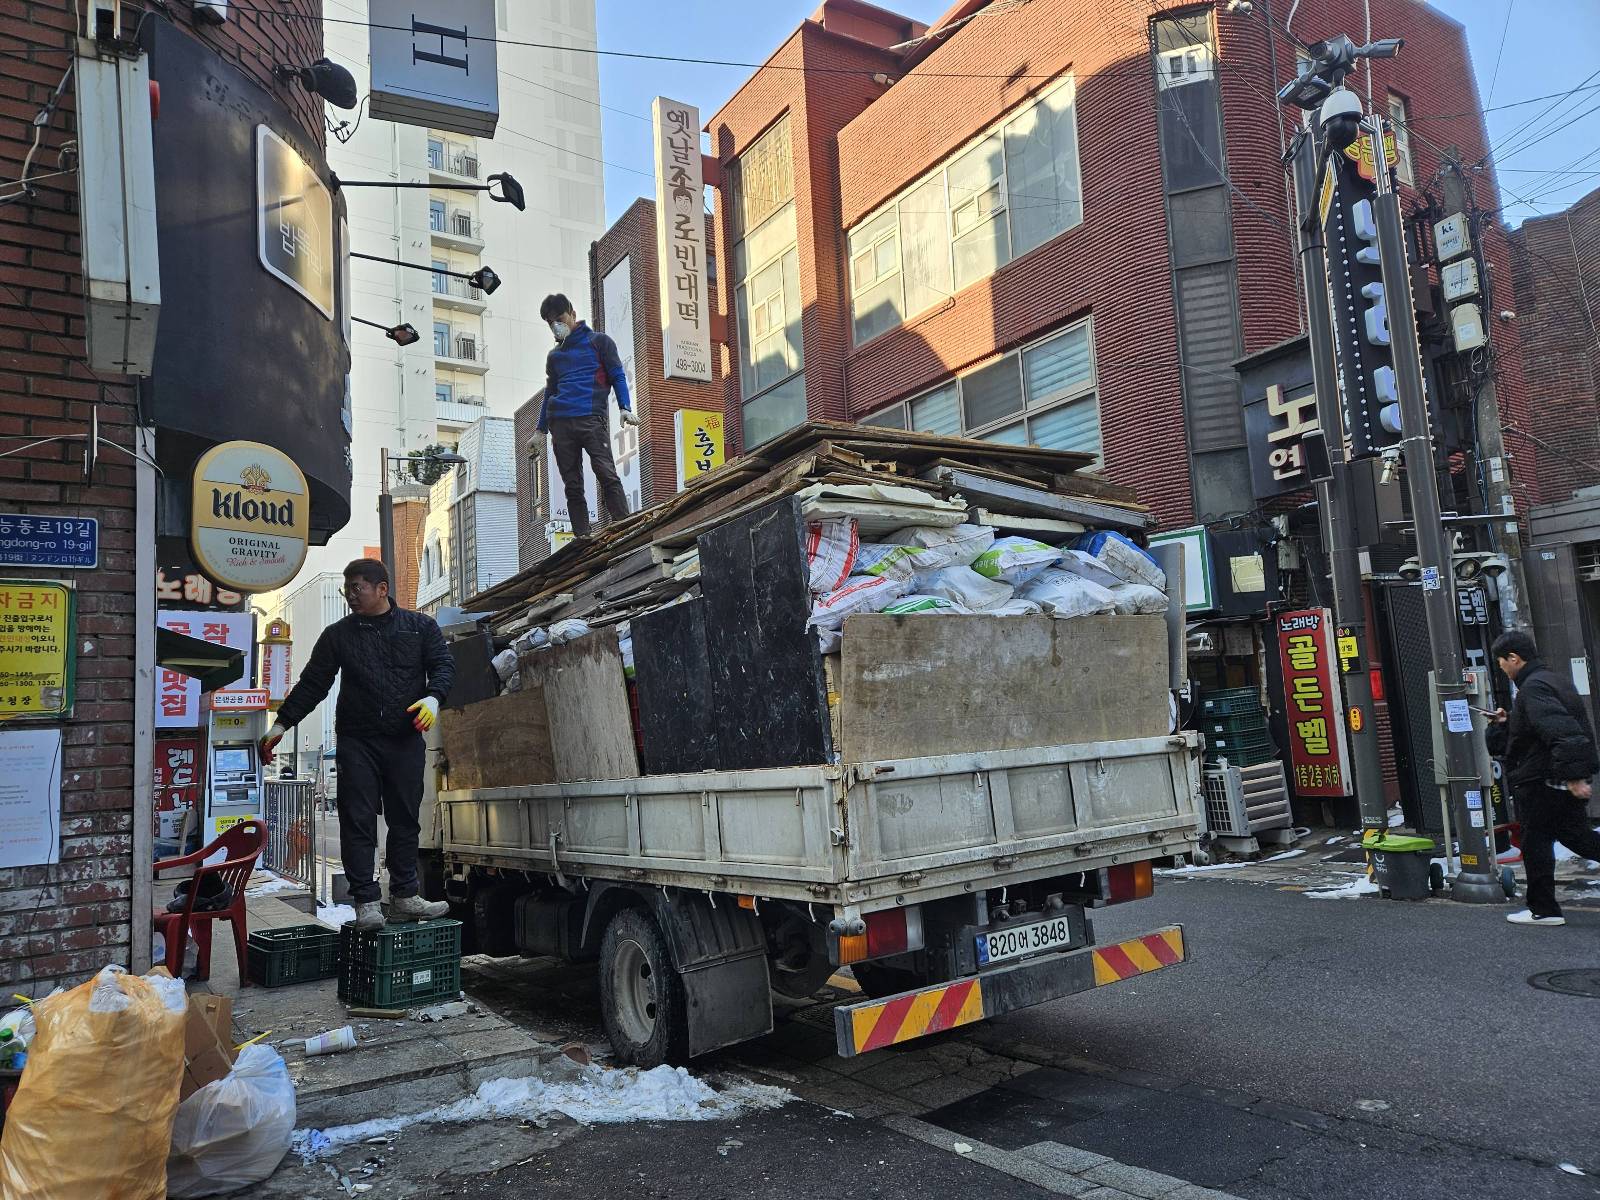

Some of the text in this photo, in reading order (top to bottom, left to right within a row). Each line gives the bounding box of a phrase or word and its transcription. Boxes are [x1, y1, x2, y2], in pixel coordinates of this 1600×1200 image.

[211, 487, 295, 528] Kloud
[228, 537, 281, 550] ORIGINAL
[231, 547, 278, 559] GRAVITY
[1280, 615, 1320, 631] 노래방
[245, 695, 266, 704] ATM
[1287, 635, 1330, 755] 골든벨
[1031, 920, 1066, 948] 3848
